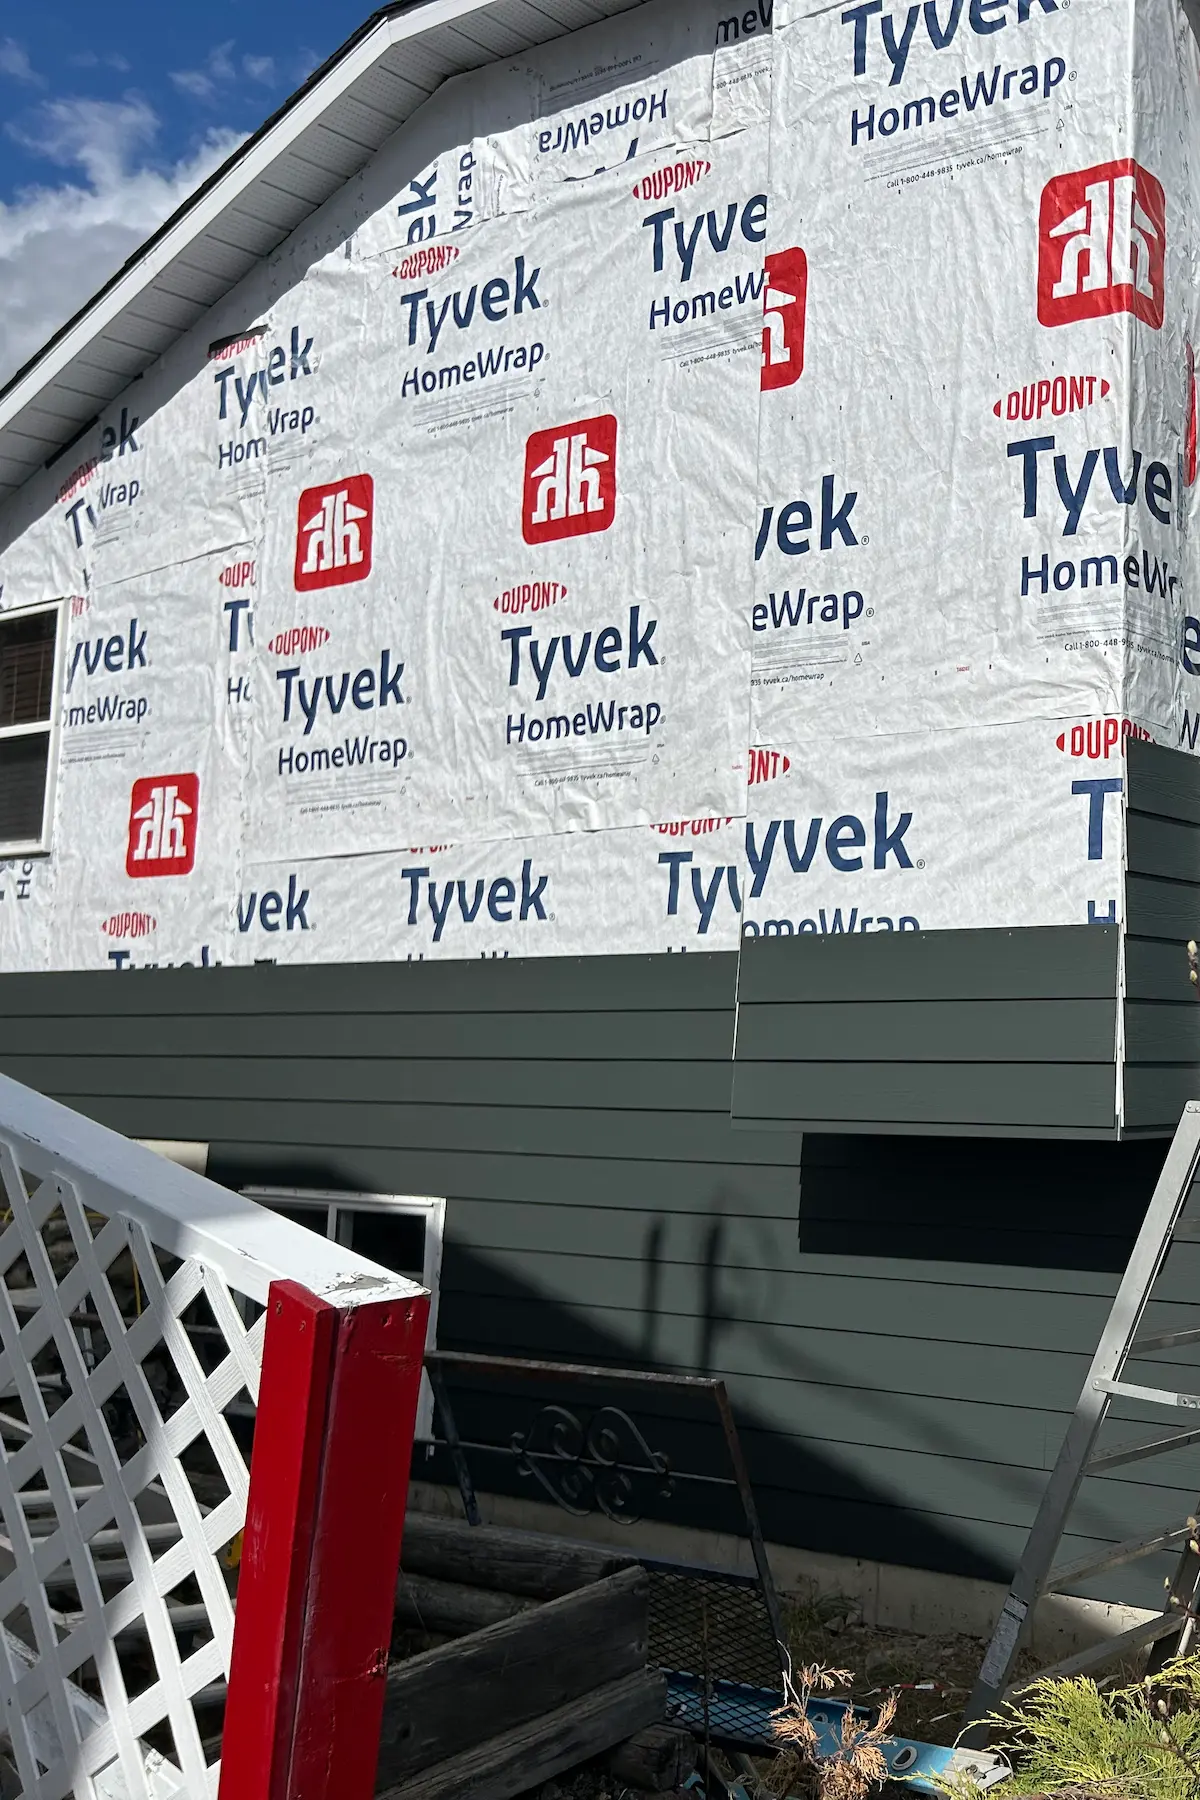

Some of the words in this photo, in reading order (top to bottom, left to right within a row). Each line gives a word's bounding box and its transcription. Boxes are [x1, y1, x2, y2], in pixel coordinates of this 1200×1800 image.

[851, 56, 1066, 146] HomeWrap
[642, 160, 706, 200] DUPONT
[400, 244, 456, 280] DUPONT
[400, 256, 541, 355] Tyvek
[401, 341, 546, 398] HomeWrap
[1006, 375, 1098, 421] DUPONT
[502, 581, 560, 614] DUPONT
[275, 626, 323, 656] DUPONT
[500, 604, 659, 701] Tyvek
[276, 648, 406, 736] Tyvek
[506, 700, 662, 746] HomeWrap
[277, 735, 408, 776] HomeWrap
[401, 858, 549, 943] Tyvek
[108, 911, 152, 939] DUPONT
